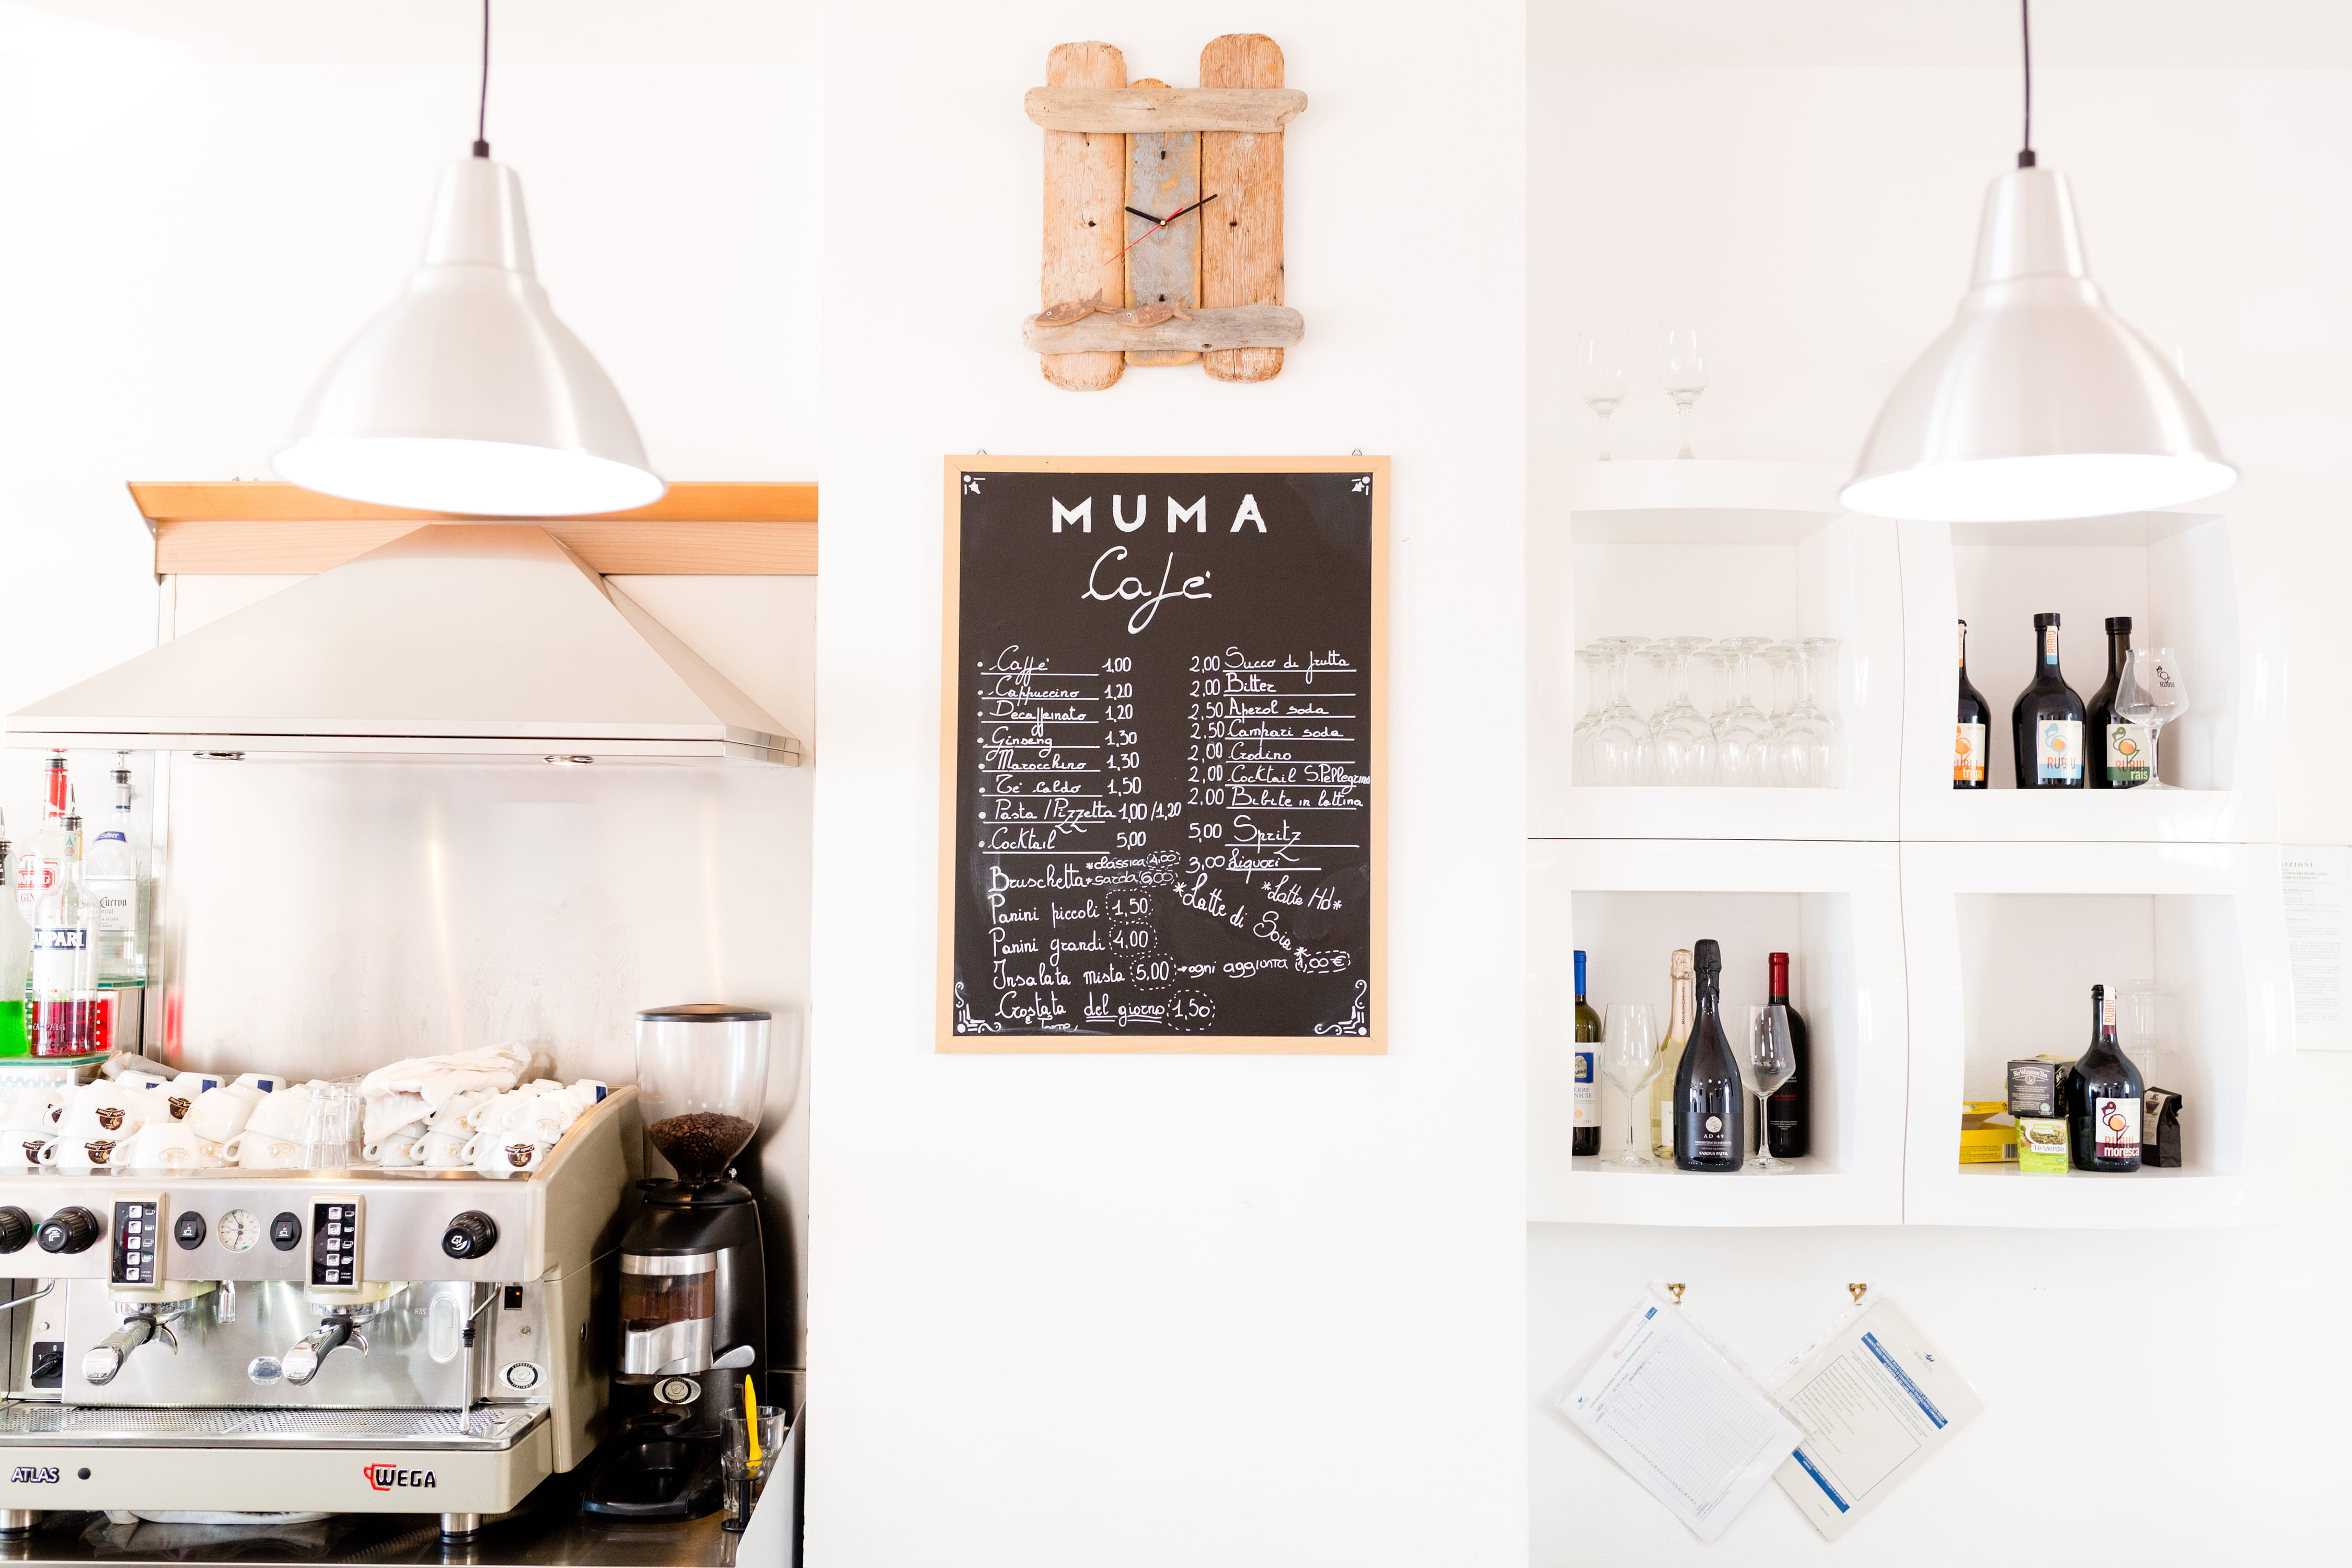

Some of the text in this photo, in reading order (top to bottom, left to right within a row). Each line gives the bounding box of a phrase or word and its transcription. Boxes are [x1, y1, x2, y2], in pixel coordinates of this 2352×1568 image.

[1052, 493, 1267, 533] MUMA
[2047, 631, 2056, 653] RUBIU
[1189, 647, 1350, 684] 2,00 Succo di frutta
[988, 675, 1079, 706] Cappuccino
[1190, 672, 1277, 697] 2,00 Bitter
[990, 700, 1086, 736] Decaffeinato
[1188, 697, 1329, 723] 2,50 Aperol soda
[985, 726, 1137, 760] Ginseng 1,30
[1227, 719, 1294, 746] Campari
[1302, 727, 1344, 737] soda
[998, 750, 1139, 770] Marocchino 1,30
[1187, 741, 1292, 763] 2,00 Crodino
[2047, 757, 2076, 769] RUBU
[1188, 765, 1223, 783] 2,00
[1963, 769, 1982, 779] triga
[2115, 760, 2145, 772] RUBIU
[1108, 777, 1142, 796] 1,50
[1187, 787, 1363, 806] 2,00 Bibite in lattina
[996, 799, 1037, 820] Pasta
[1116, 831, 1146, 850] 5,00
[1188, 815, 1301, 862] 5,00 Spritz
[1186, 856, 1225, 873] 3,00
[988, 863, 1088, 892] Bruschetta
[1092, 870, 1138, 885] sarda
[100, 896, 127, 908] Cuervo
[988, 894, 1148, 928] Panini piccoli 1,50
[1230, 906, 1248, 928] di
[1254, 911, 1292, 951] Soia
[988, 927, 1148, 966] Panini grandi 4,00
[1083, 963, 1125, 984] mista
[1135, 961, 1169, 982] 5,00
[1189, 961, 1217, 978] ogni
[995, 990, 1210, 1027] Crostata del giorno 1,50
[2105, 999, 2115, 1023] RUBIU
[2104, 1147, 2140, 1157] moresca
[11, 1466, 60, 1484] ATLAS
[375, 1467, 437, 1489] WEGA
